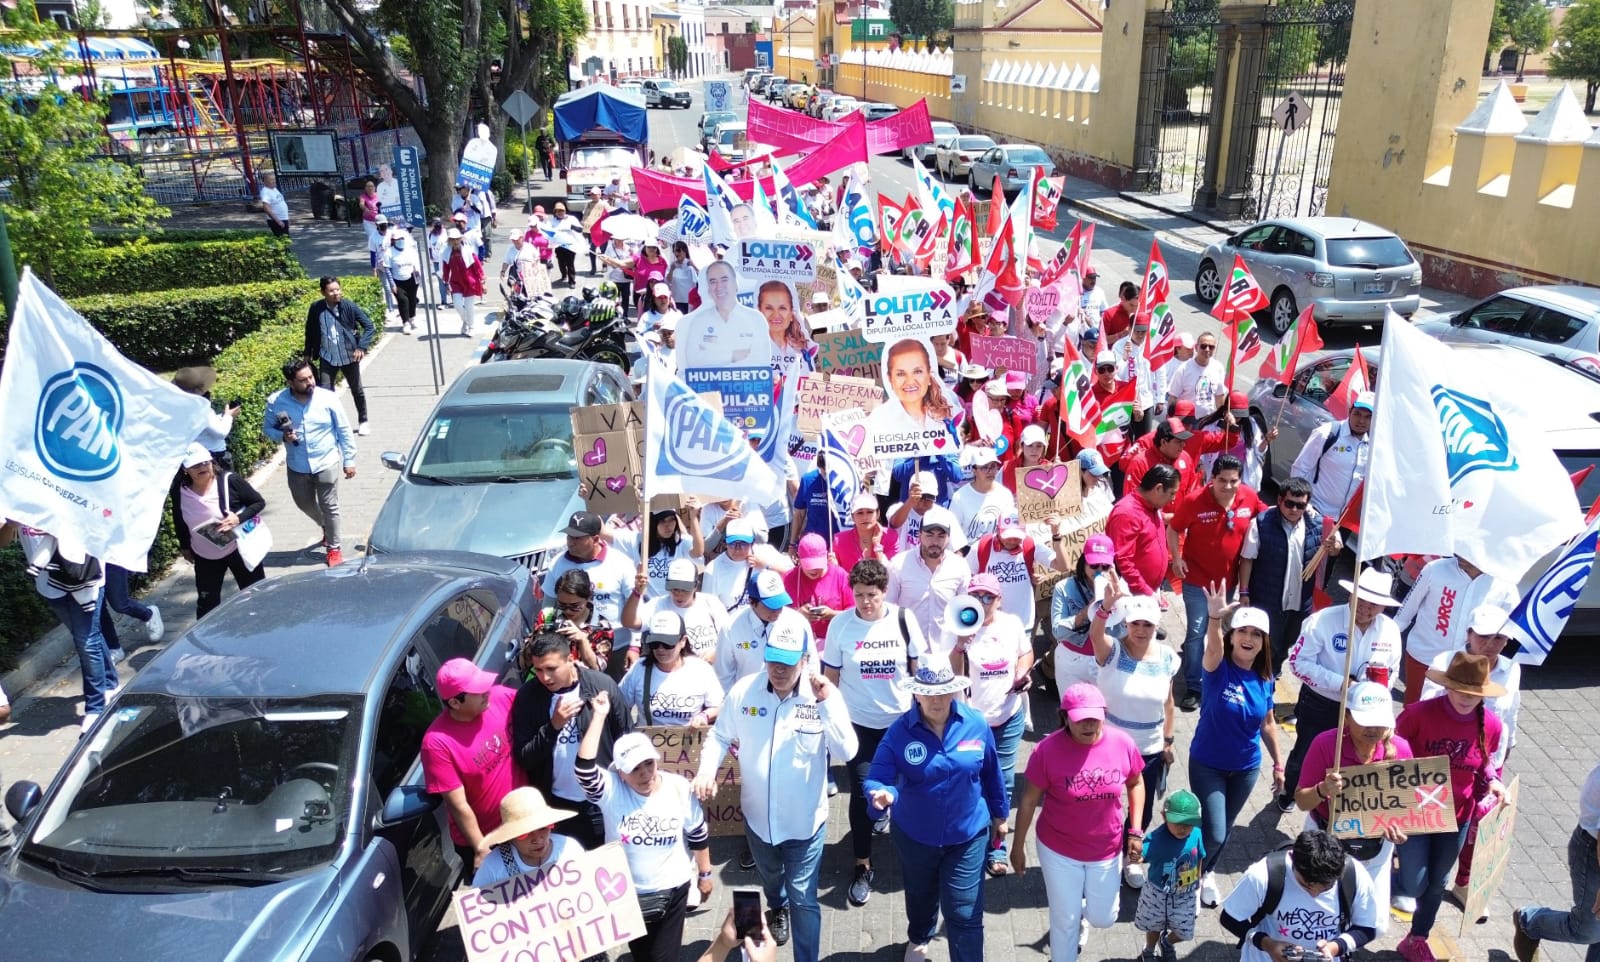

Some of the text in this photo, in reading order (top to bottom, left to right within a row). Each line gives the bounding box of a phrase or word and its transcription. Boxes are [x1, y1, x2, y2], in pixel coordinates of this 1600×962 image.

[460, 169, 490, 184] AGUILAR
[742, 242, 798, 259] LOLITA
[743, 258, 812, 270] PARRA
[865, 292, 933, 317] LOLITA
[866, 309, 951, 327] PARRA
[866, 326, 902, 335] DIPUTADA
[902, 323, 924, 332] LOCAL
[822, 356, 832, 369] A
[688, 370, 770, 382] HUMBERTO
[722, 394, 770, 406] UILAR
[46, 384, 115, 460] PAN
[675, 404, 736, 455] PAN
[873, 430, 946, 443] LEGISLAR CON
[874, 441, 929, 454] FUERZA Y
[1436, 586, 1457, 637] JORGE
[856, 640, 900, 650] XOCHITL
[860, 666, 896, 674] MÉXICO
[908, 746, 924, 758] PAN
[1386, 763, 1448, 789] Pedro
[1333, 818, 1364, 836] con
[460, 859, 582, 924] ESTAMOS
[470, 891, 594, 953] CONTIGO
